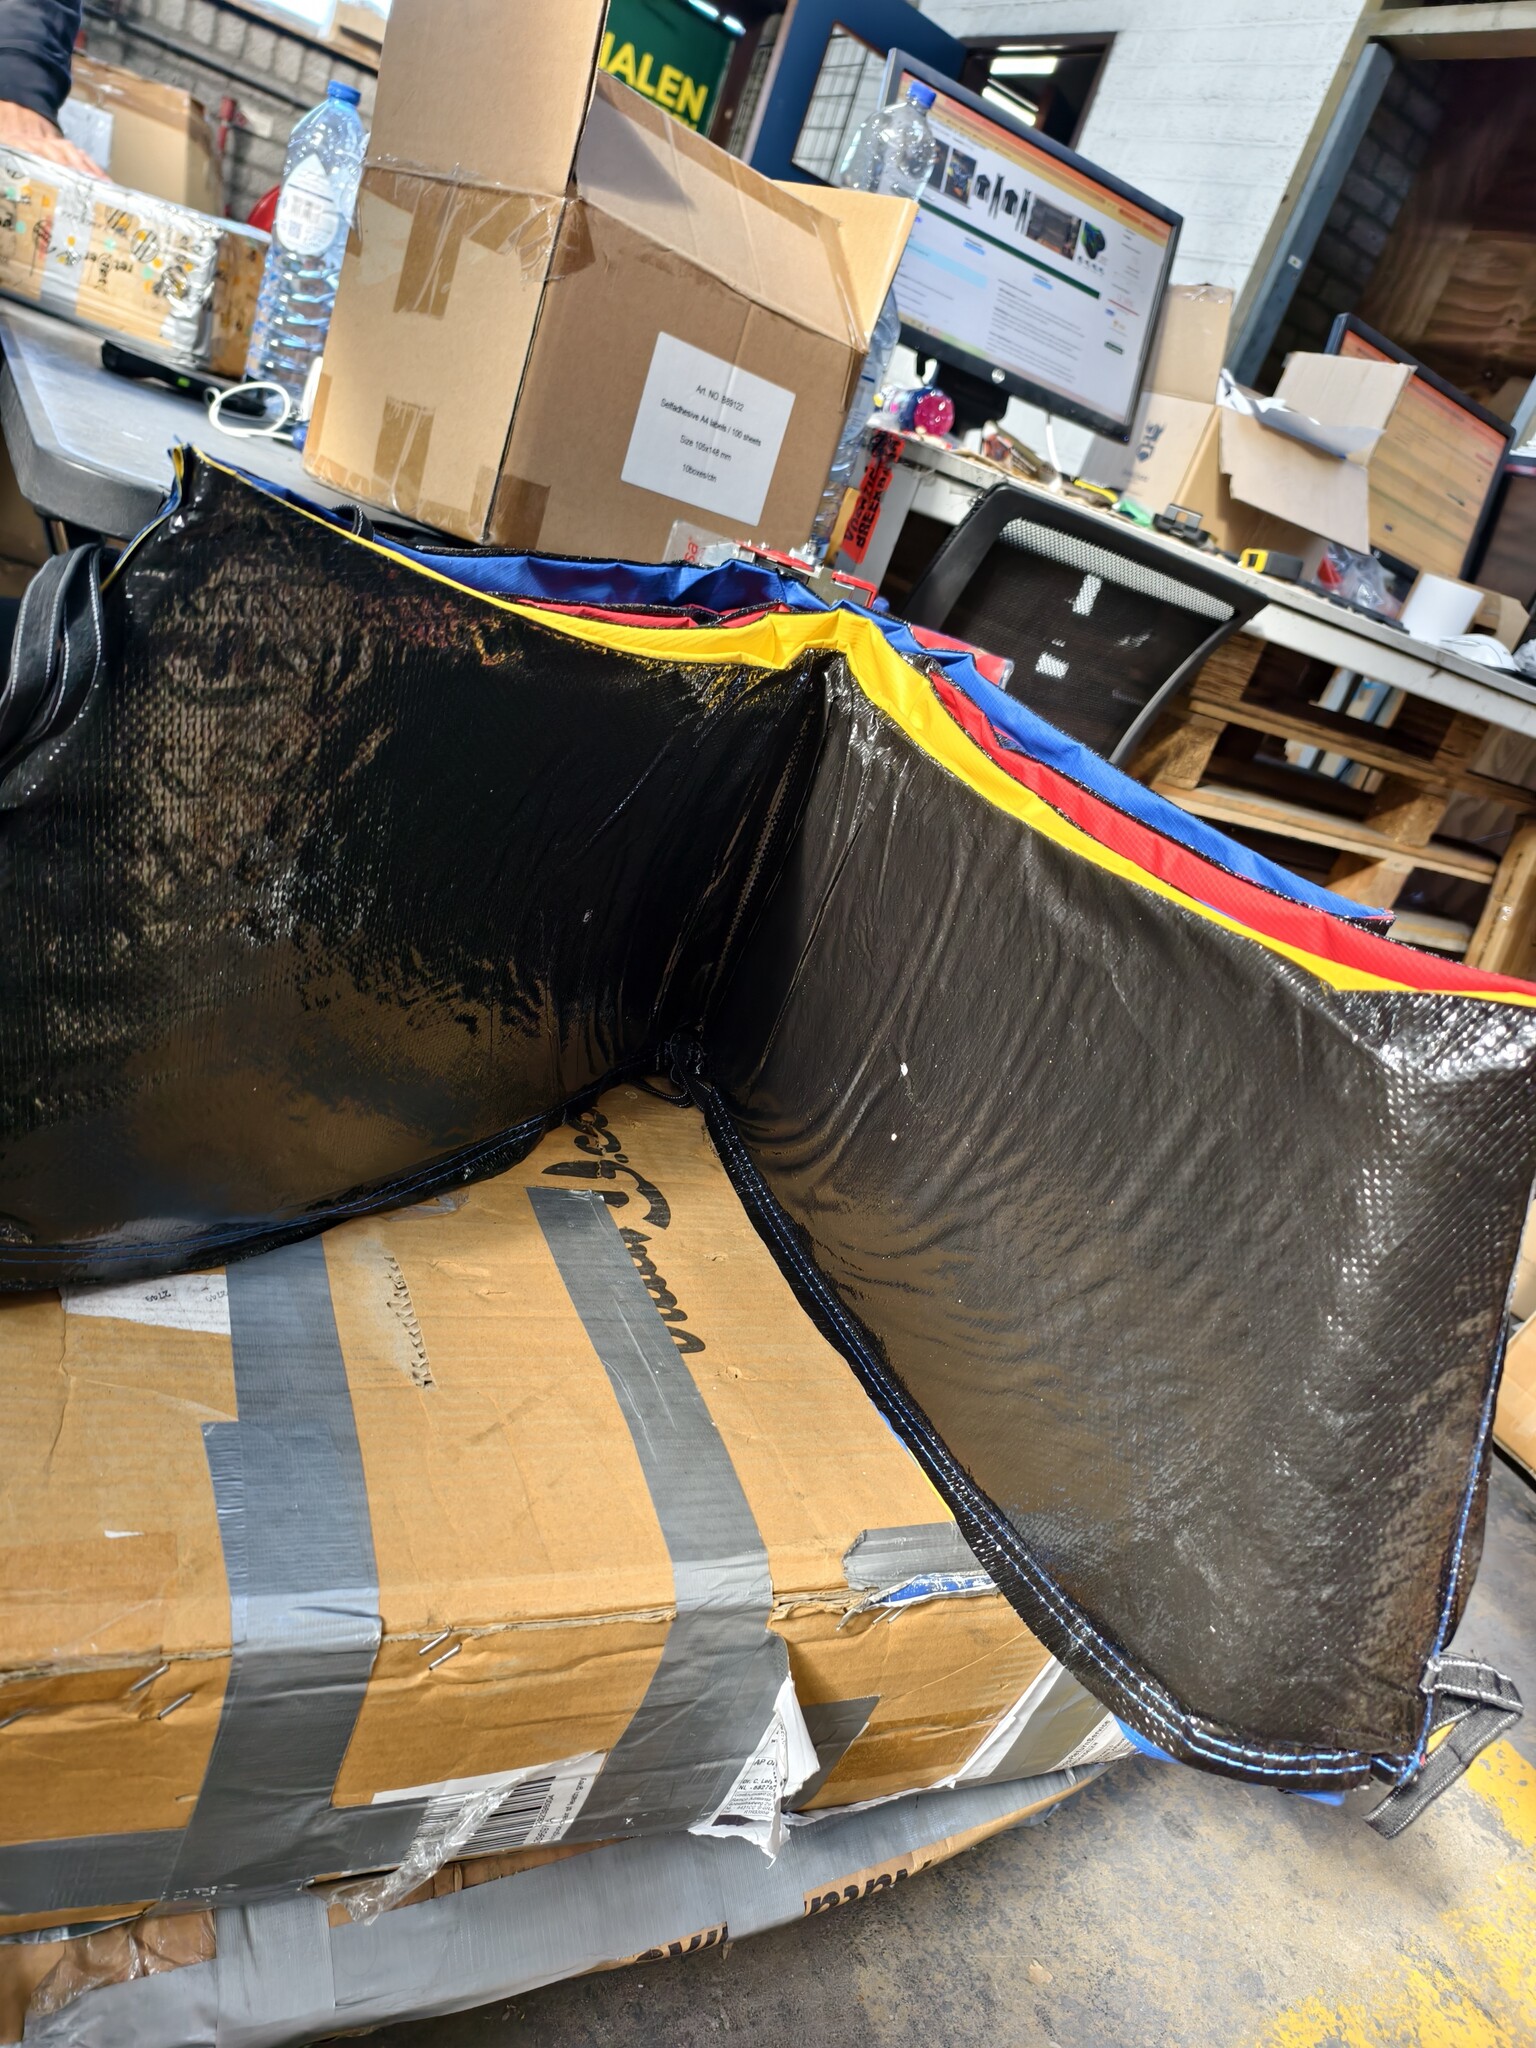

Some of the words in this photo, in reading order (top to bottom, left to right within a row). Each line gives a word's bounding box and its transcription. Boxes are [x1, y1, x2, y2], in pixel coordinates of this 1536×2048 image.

[699, 415, 709, 425] A4
[732, 428, 742, 438] 100
[680, 434, 694, 446] Size
